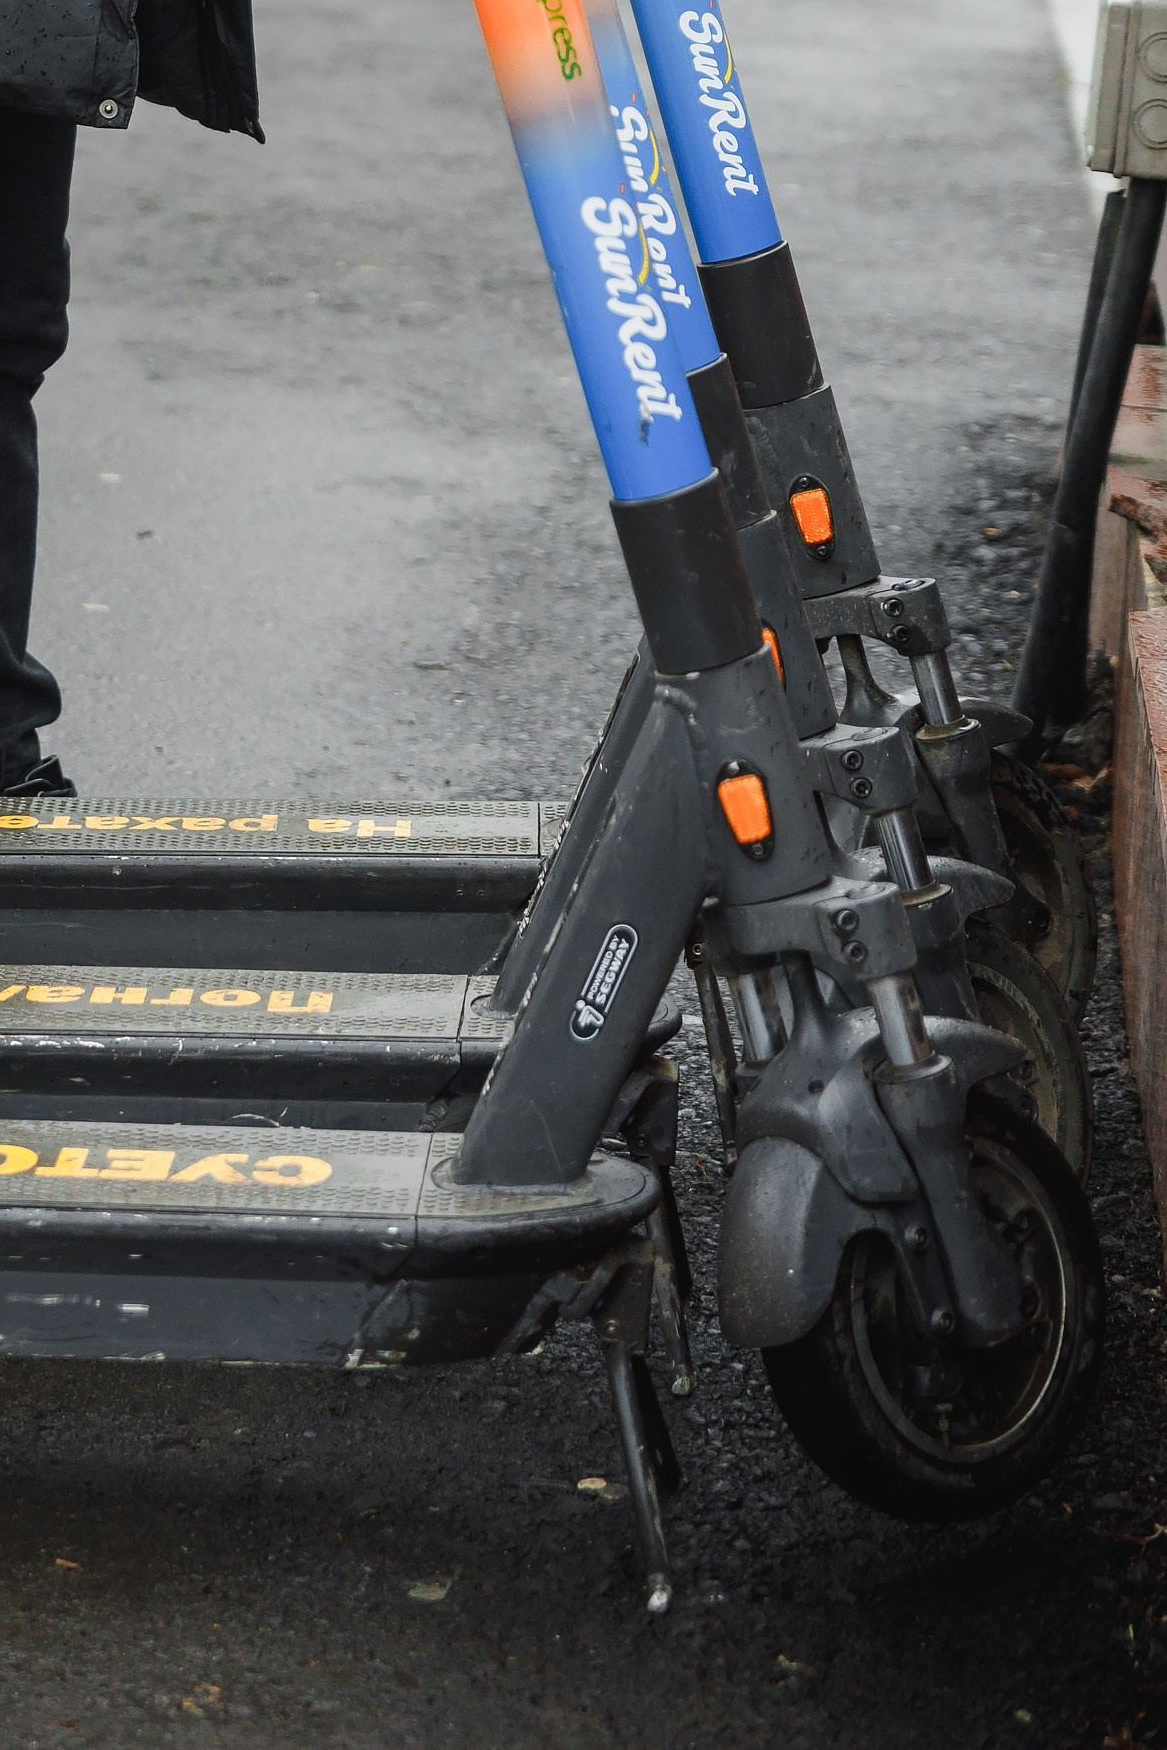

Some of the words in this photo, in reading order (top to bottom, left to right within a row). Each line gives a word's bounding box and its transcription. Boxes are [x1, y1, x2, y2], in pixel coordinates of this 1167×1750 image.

[679, 9, 759, 197] SunRent
[581, 195, 683, 424] SunRent
[307, 817, 413, 838] На
[586, 950, 614, 1001] POWERED
[608, 934, 620, 951] BY
[595, 937, 630, 1006] SEGWAY
